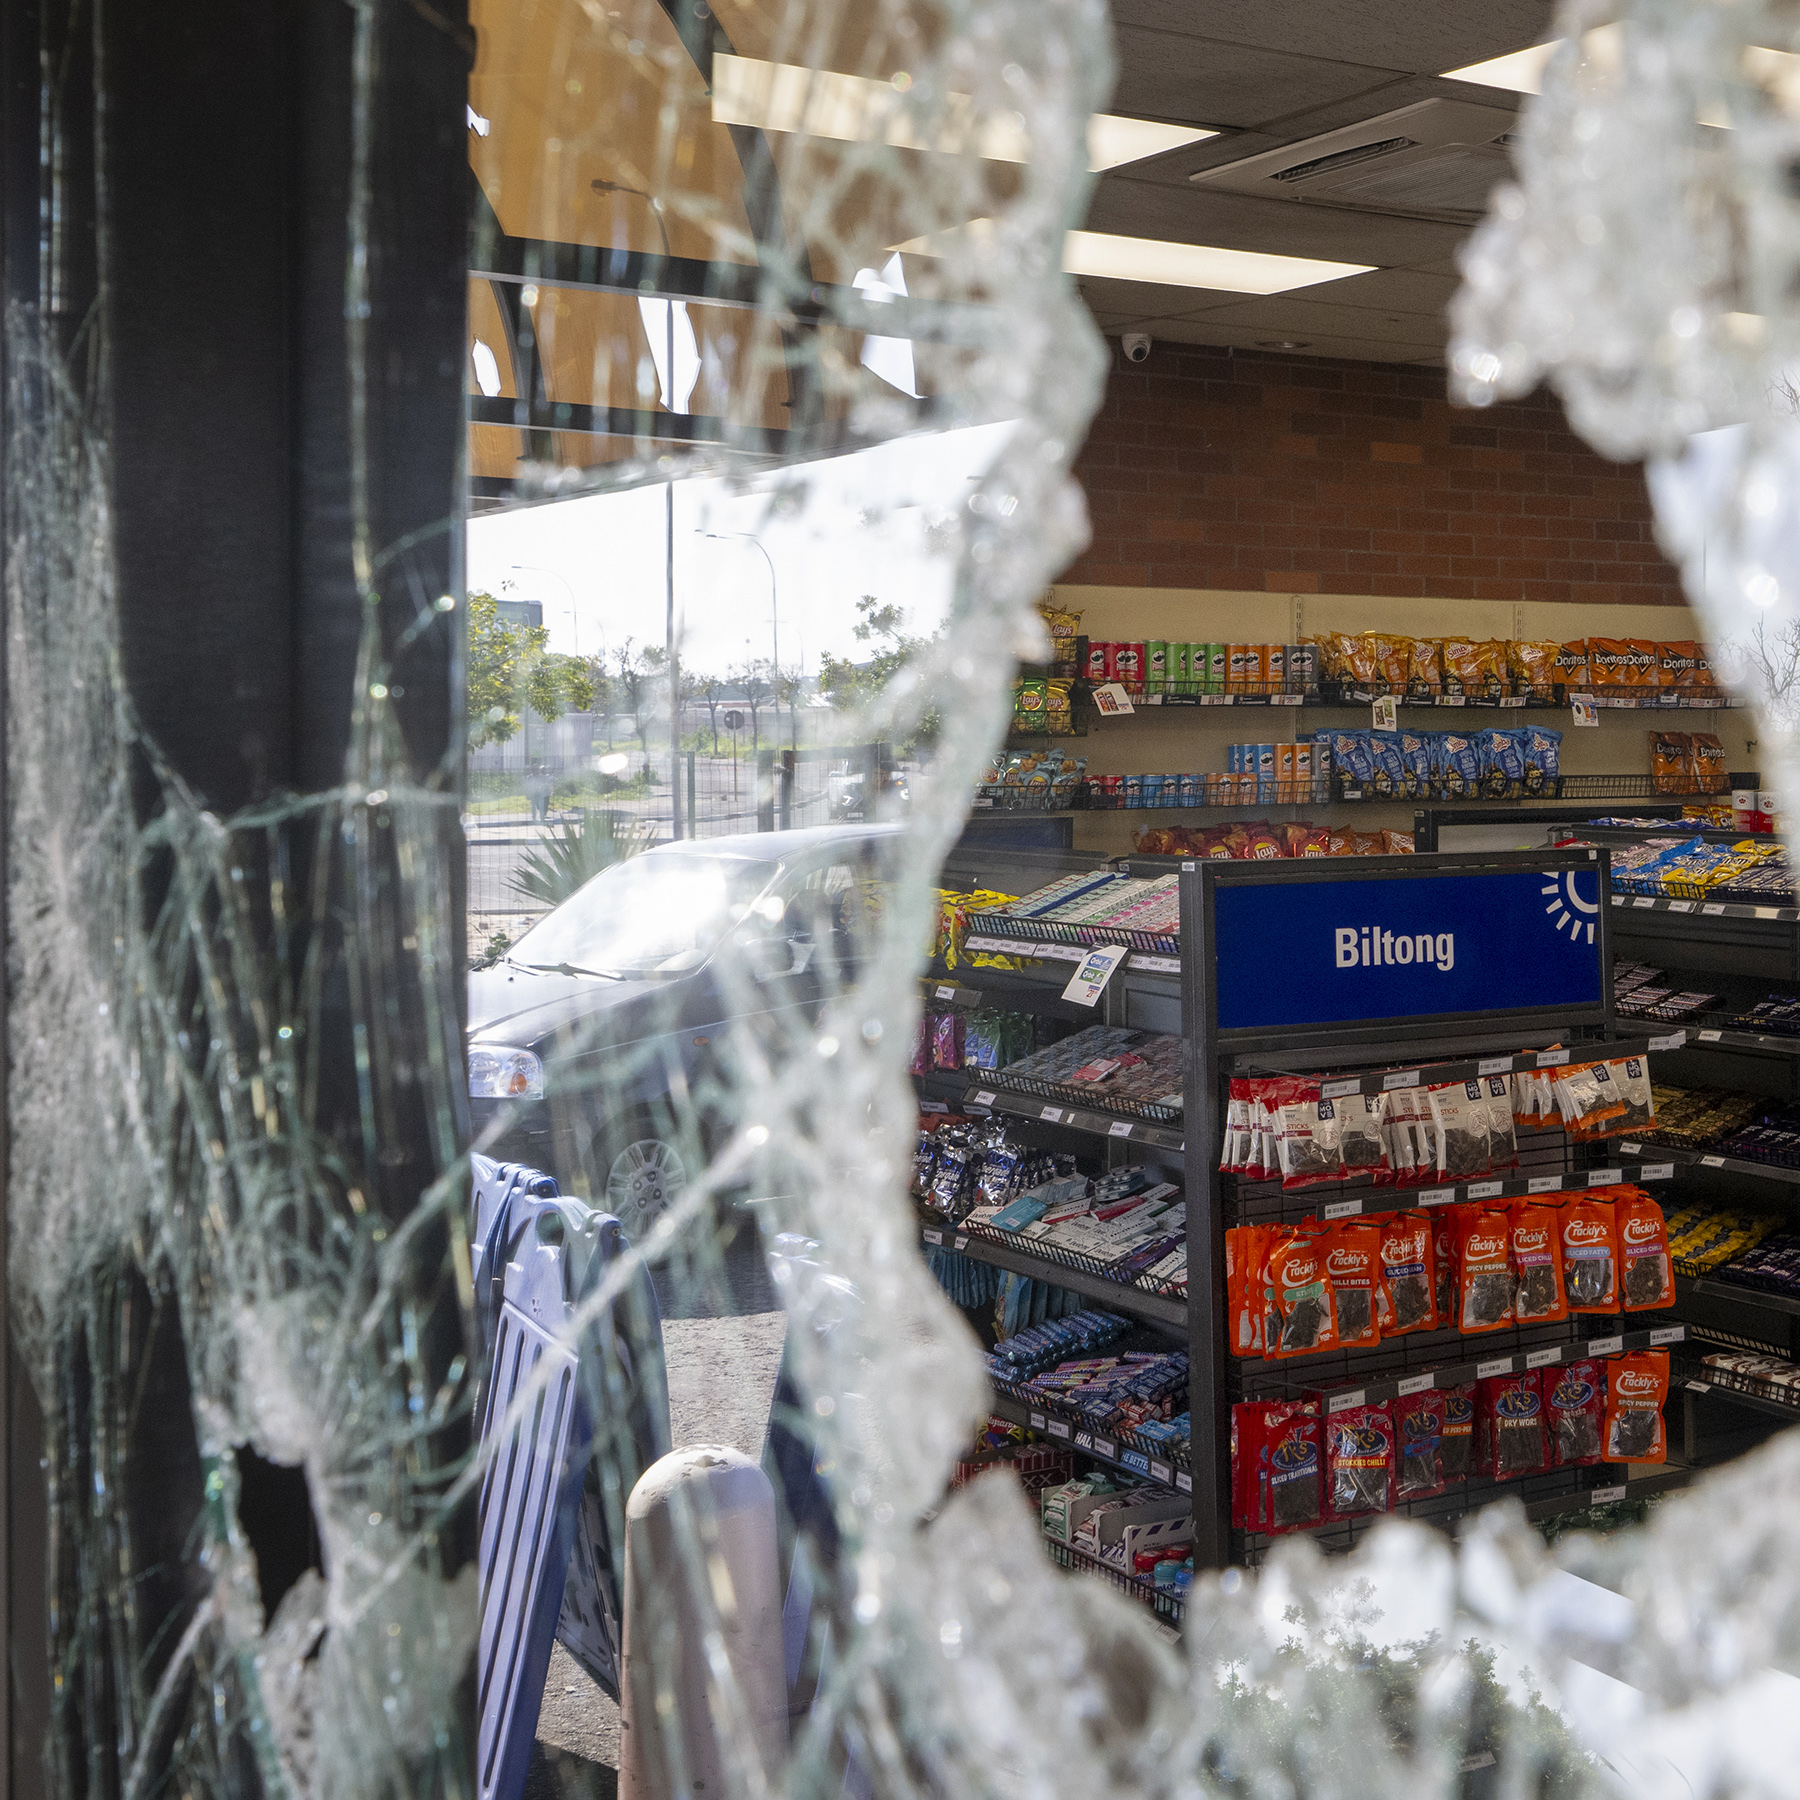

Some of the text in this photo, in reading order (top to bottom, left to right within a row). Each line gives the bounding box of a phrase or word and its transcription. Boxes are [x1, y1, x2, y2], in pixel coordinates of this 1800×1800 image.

[1555, 655, 1586, 667] Doritos
[1595, 653, 1627, 665] Doritos
[1663, 658, 1695, 669] Doritos
[1335, 926, 1455, 971] Biltong
[1440, 1107, 1459, 1116] STICKS
[1564, 1219, 1608, 1247] Crackly's
[1623, 1217, 1661, 1245] Crackly's
[1465, 1234, 1505, 1262] Crackly's
[1588, 1248, 1610, 1256] FATTY
[1626, 1247, 1647, 1255] SLICED
[1326, 1248, 1370, 1275] Crackly's
[1465, 1262, 1507, 1273] SPICY PEPPER
[1281, 1258, 1319, 1288] Crackly's
[1331, 1278, 1371, 1286] HILLI BITES
[1615, 1369, 1662, 1396] Crackly's
[1504, 1417, 1538, 1428] DRY WORS
[1074, 1431, 1093, 1450] HAL
[1337, 1457, 1386, 1468] STOKKIES CHILLI
[1271, 1474, 1288, 1486] SLICED
